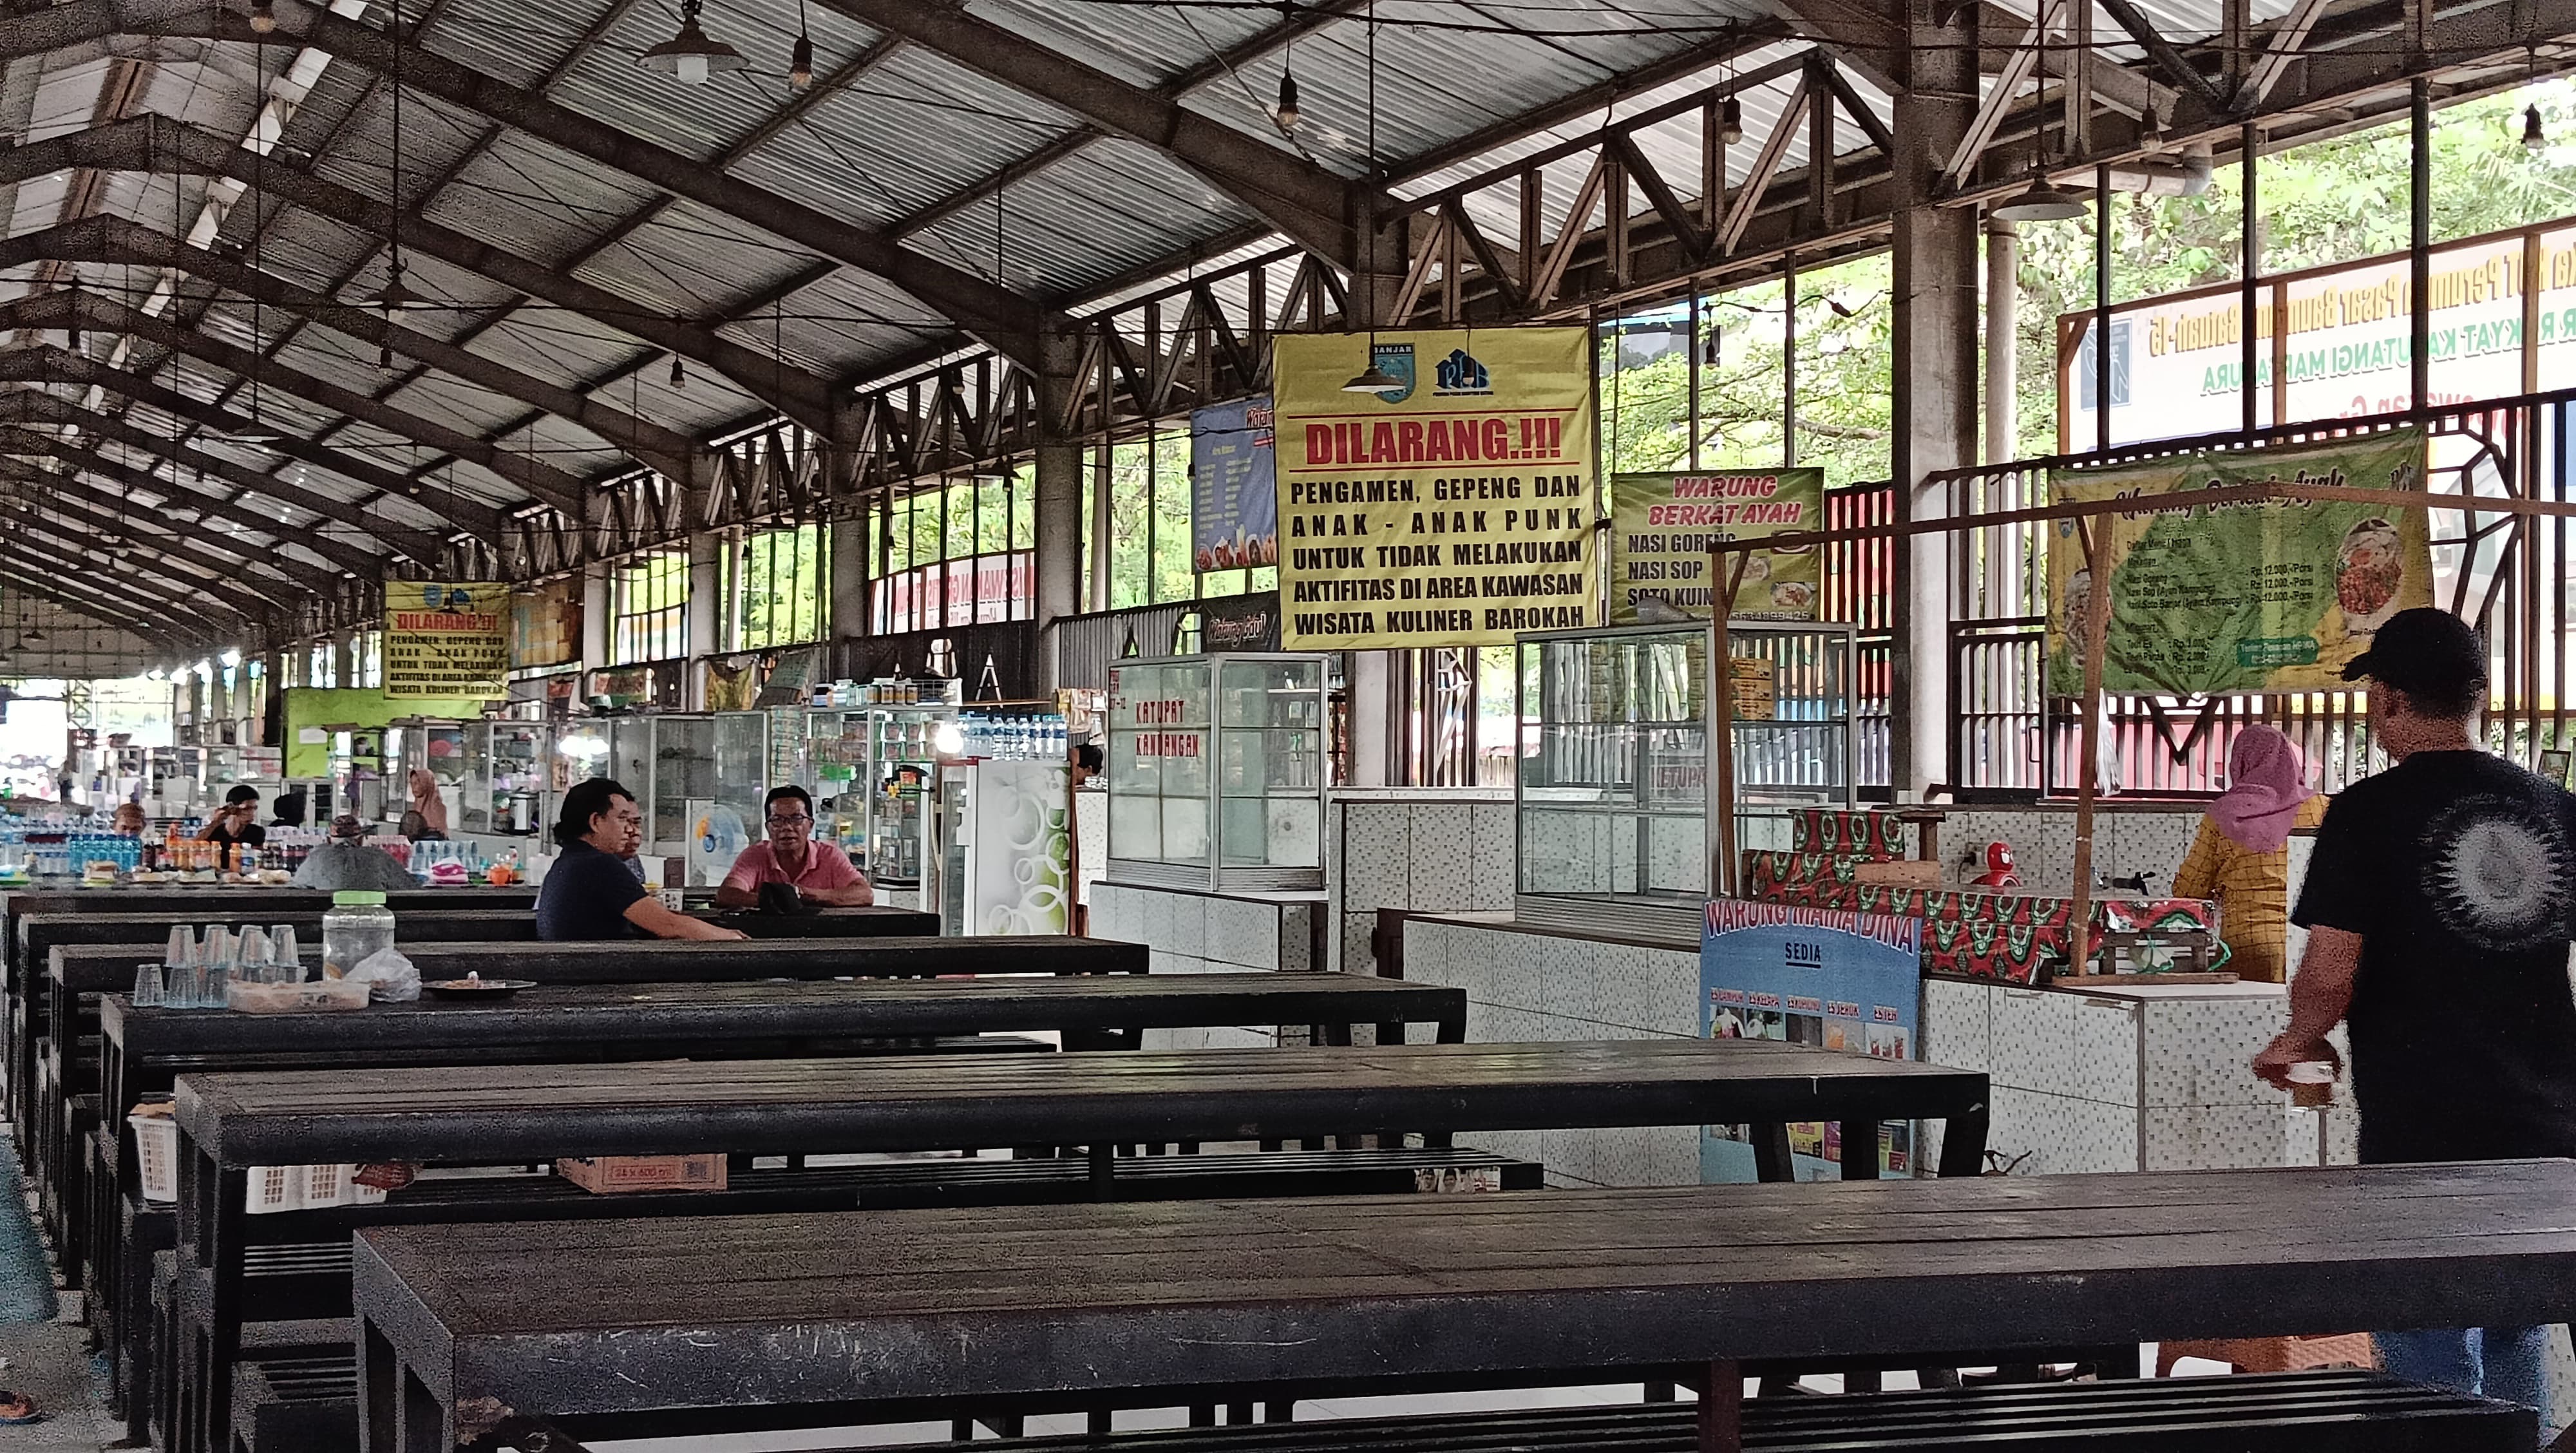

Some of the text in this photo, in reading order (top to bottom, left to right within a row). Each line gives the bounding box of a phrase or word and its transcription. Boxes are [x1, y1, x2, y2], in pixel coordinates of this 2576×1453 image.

[1305, 417, 1561, 464] DILARANG.!!!
[1291, 475, 1580, 505] PENGAMEN, GEPENG DAN
[1673, 475, 1778, 499] WARUNG
[1291, 513, 1368, 537] ANAK
[1411, 510, 1488, 534] ANAK
[1505, 508, 1582, 531] PUNK
[1648, 502, 1803, 526] BERKAT AYAH
[1293, 540, 1582, 570] UNTUK TIDAK MELAKUKAN
[1628, 534, 1666, 553] NASI
[1628, 561, 1703, 580] NASI SOP
[1294, 573, 1583, 602] AKTIFITAS DI AREA KAWASAN
[1294, 606, 1584, 635] WISATA KULINER BAROKAH
[390, 648, 421, 656] ANAK
[437, 649, 467, 657] ANAK
[390, 661, 419, 669] UNTUK
[424, 661, 449, 669] TIDAK
[390, 685, 421, 694] WISATA
[426, 685, 460, 694] KULINER
[1135, 700, 1184, 724] KATUPAT
[1135, 734, 1198, 758] KANDANGAN
[1705, 900, 1915, 956] WARUNG MAMA DINA
[1785, 942, 1821, 962] SEDIA
